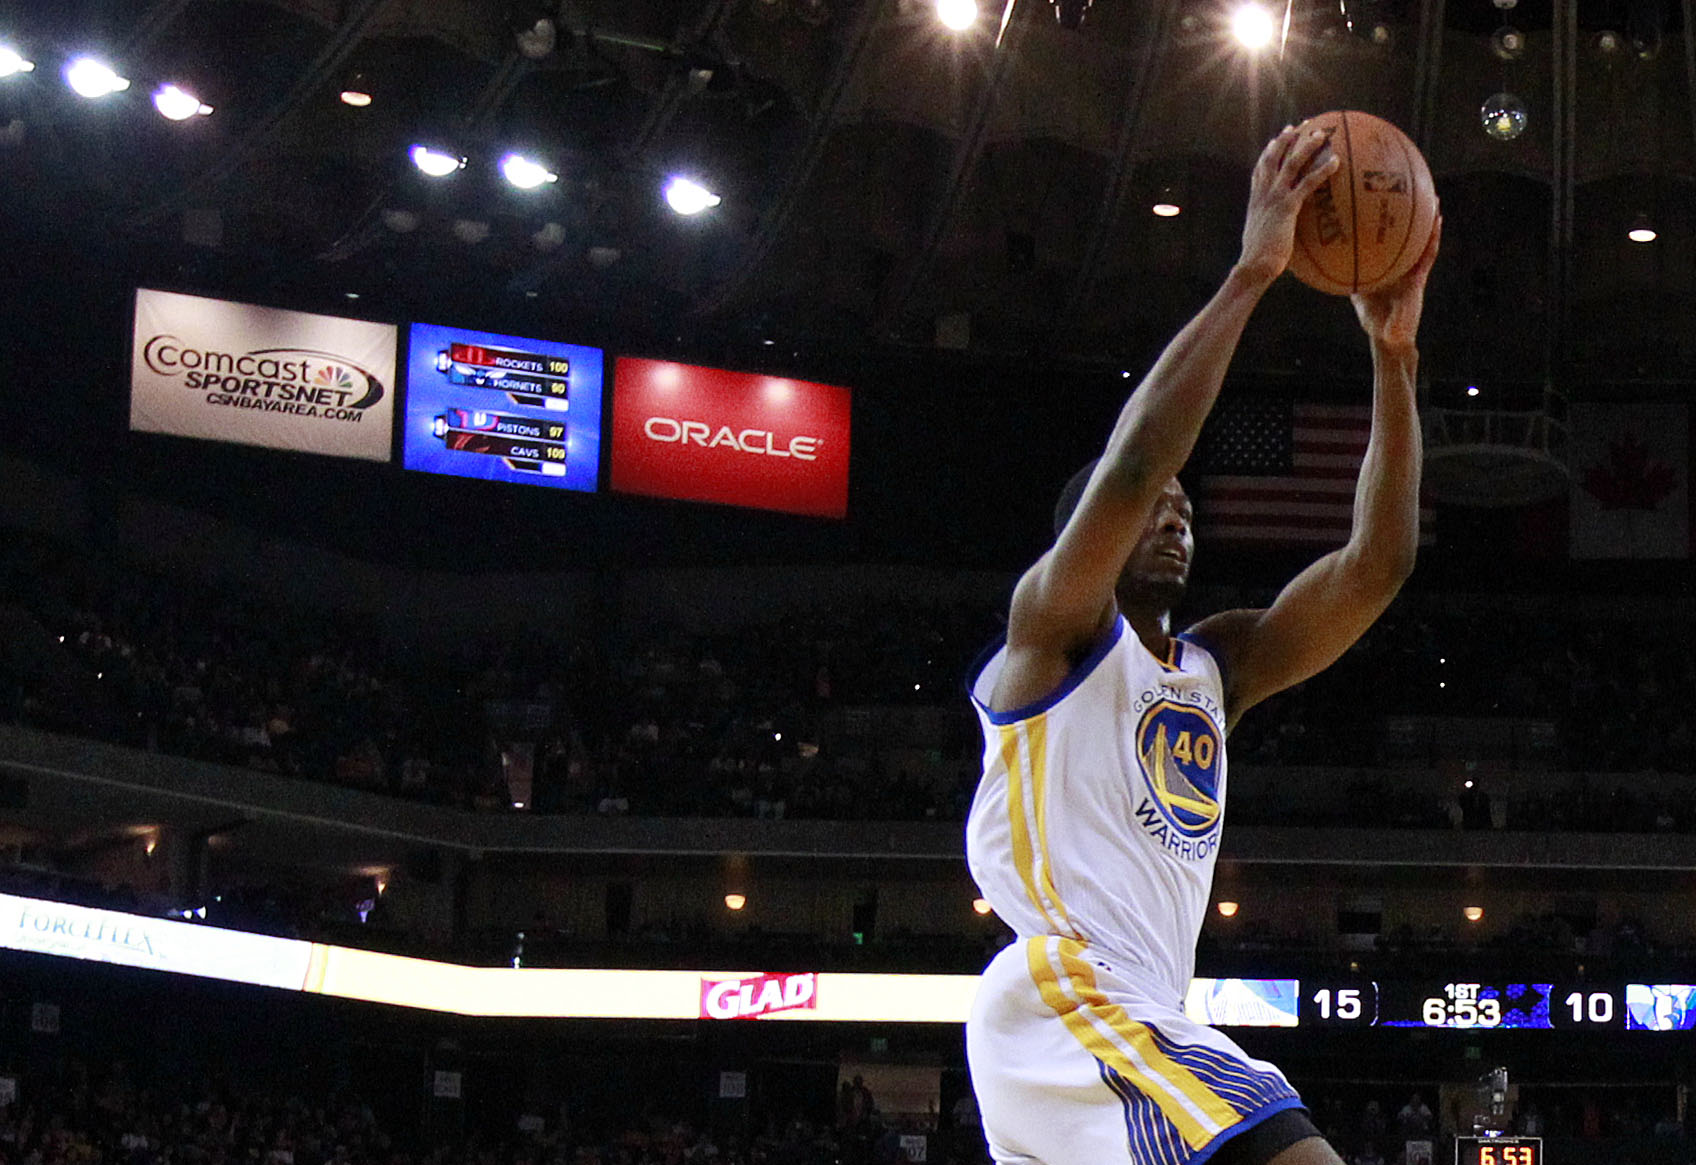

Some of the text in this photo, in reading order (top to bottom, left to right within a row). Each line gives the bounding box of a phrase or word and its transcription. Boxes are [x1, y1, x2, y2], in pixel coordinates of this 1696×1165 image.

[495, 357, 543, 372] ROCKETS
[184, 371, 353, 407] SPORTSNET
[493, 379, 542, 393] HORNETS
[206, 392, 363, 423] CSNBAYAREA.COM
[497, 422, 540, 436] PISTONS
[644, 416, 818, 461] ORACLE
[510, 446, 540, 458] CAVS
[1173, 731, 1215, 770] 40
[1135, 798, 1218, 859] WARRIOR
[706, 973, 815, 1020] GLAD
[1313, 989, 1362, 1020] 15
[1444, 983, 1481, 999] 1ST
[1423, 998, 1501, 1026] 6:53
[1565, 992, 1614, 1022] 10
